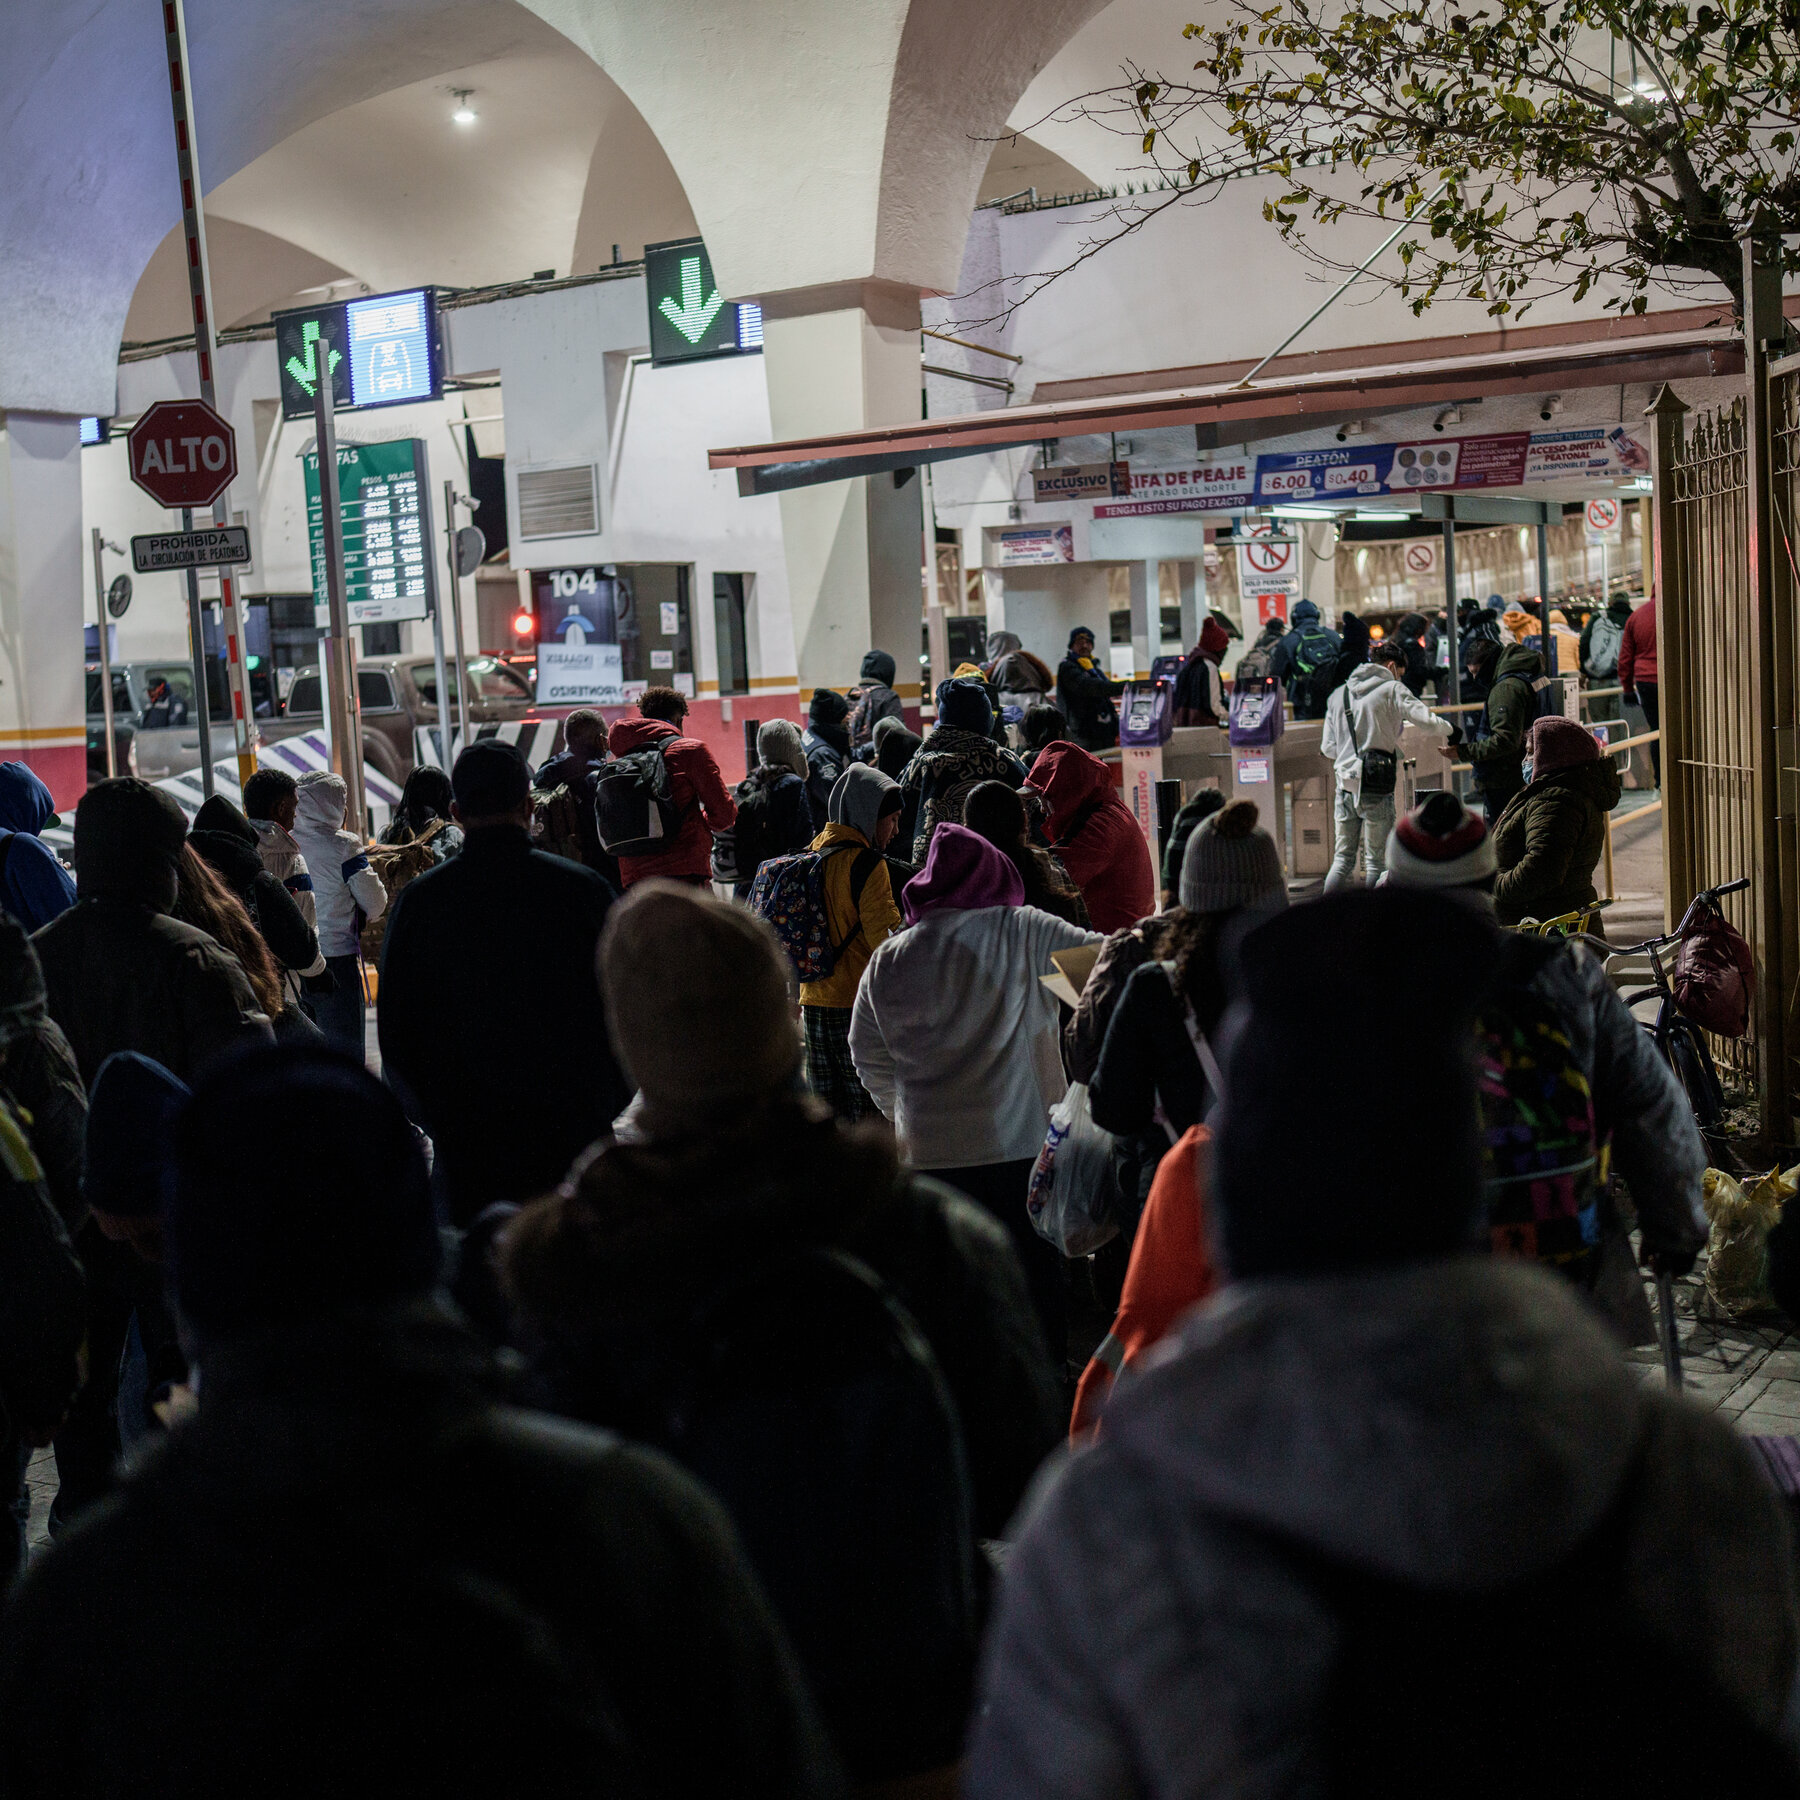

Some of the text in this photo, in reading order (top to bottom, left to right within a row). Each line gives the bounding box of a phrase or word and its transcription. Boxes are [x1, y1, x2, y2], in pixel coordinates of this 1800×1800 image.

[141, 435, 227, 475] ALTO
[1529, 441, 1606, 455] ACCESO DIGITAL
[1545, 451, 1590, 462] PEATONAL
[308, 450, 359, 470] TFAS
[1295, 450, 1350, 468] PEATÓN
[1037, 474, 1107, 491] EXCLUSIVO
[1129, 466, 1247, 490] RIFA DE PEAJE
[1265, 474, 1306, 490] $6.00
[1329, 469, 1368, 485] $0.40
[1153, 487, 1177, 497] PASO
[1182, 486, 1200, 495] DEL
[1204, 483, 1237, 493] NORTE
[1105, 496, 1246, 516] TENGA LISTO SU PAGO EXACTO
[150, 533, 229, 551] PROHIBIDA
[139, 545, 245, 567] LA CIRCULACIÓN DE PEATONES
[549, 568, 598, 598] 104
[1250, 587, 1292, 595] AUTORIZADO
[210, 598, 250, 626] 13
